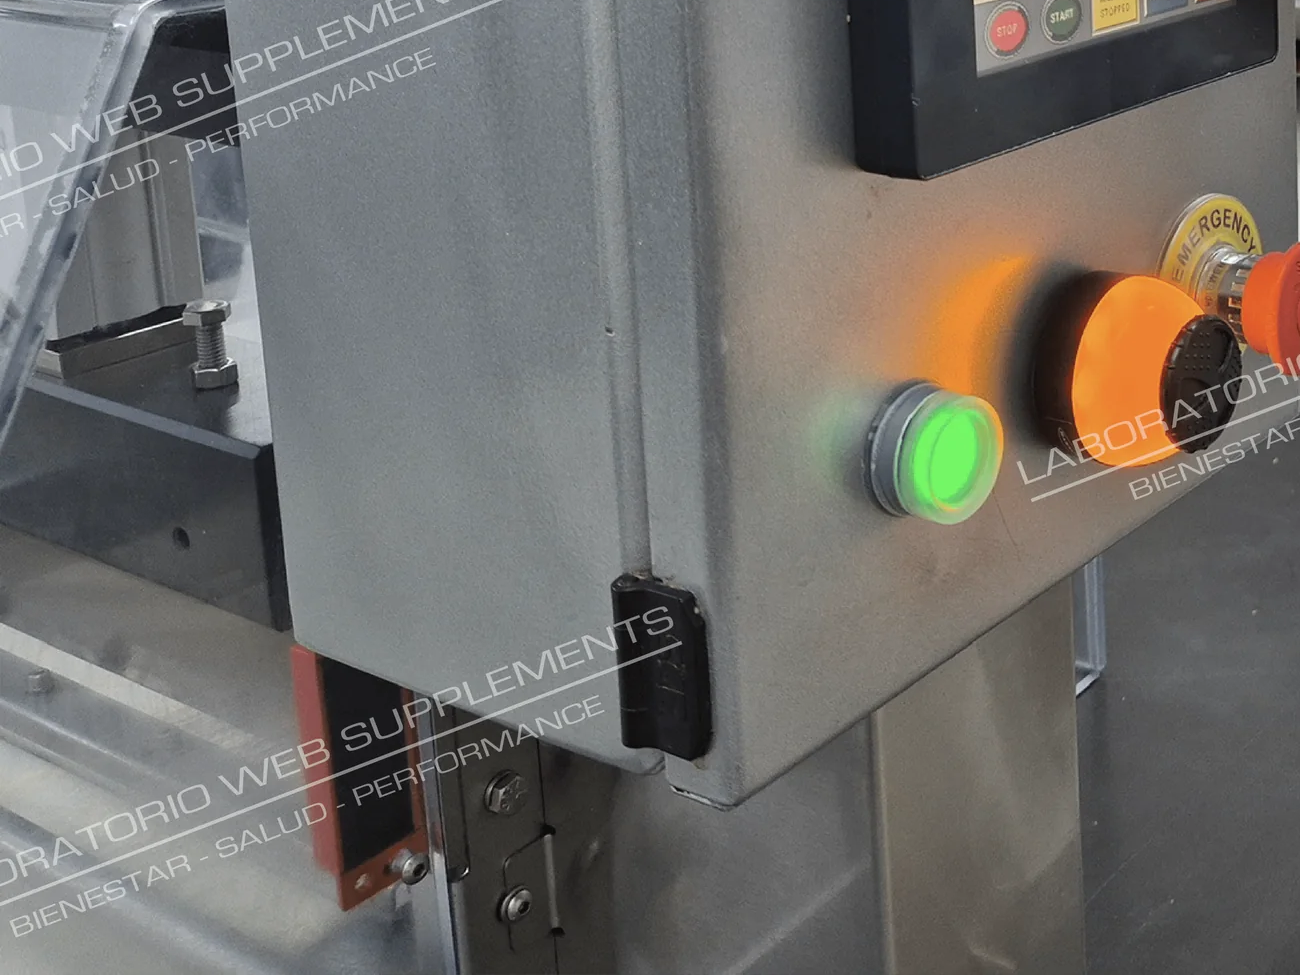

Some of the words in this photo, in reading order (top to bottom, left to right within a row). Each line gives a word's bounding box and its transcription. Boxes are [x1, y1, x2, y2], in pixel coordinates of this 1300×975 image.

[1050, 7, 1074, 23] START
[1099, 4, 1130, 19] STOPPED
[996, 23, 1018, 38] STOP
[1171, 208, 1257, 283] EMERGENCY
